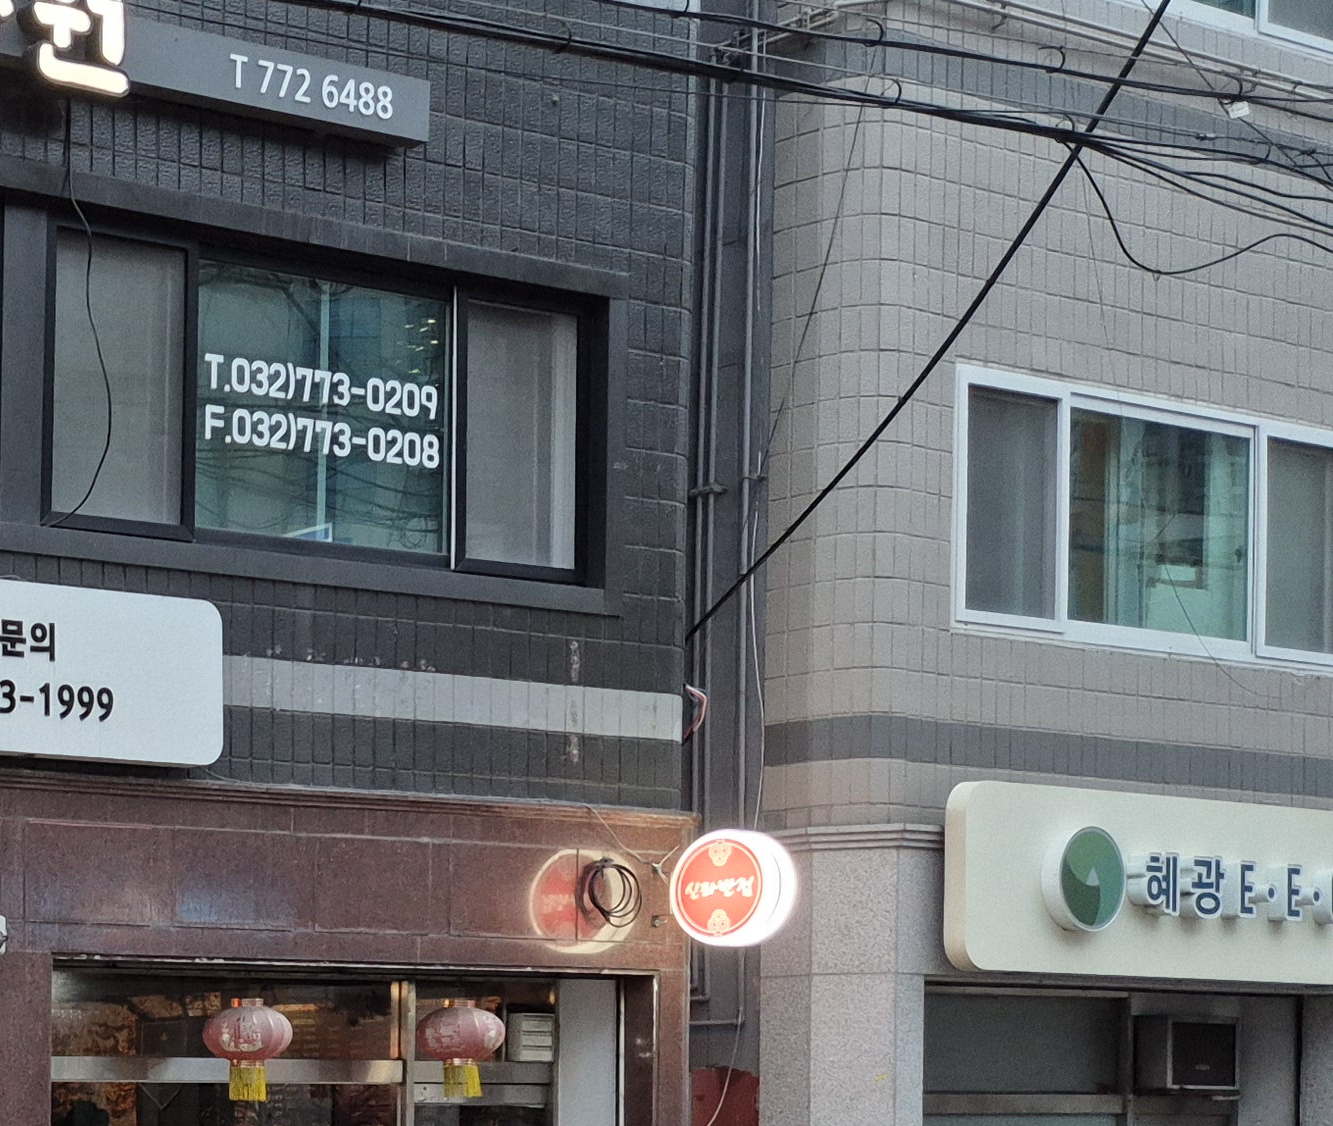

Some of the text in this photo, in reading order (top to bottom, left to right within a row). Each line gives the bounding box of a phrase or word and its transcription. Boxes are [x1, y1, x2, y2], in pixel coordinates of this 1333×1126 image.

[229, 54, 394, 120] T 772 6488
[205, 353, 439, 420] T.032)773-0209
[205, 405, 440, 469] F.032)773-0208
[684, 876, 755, 900] 신라반점
